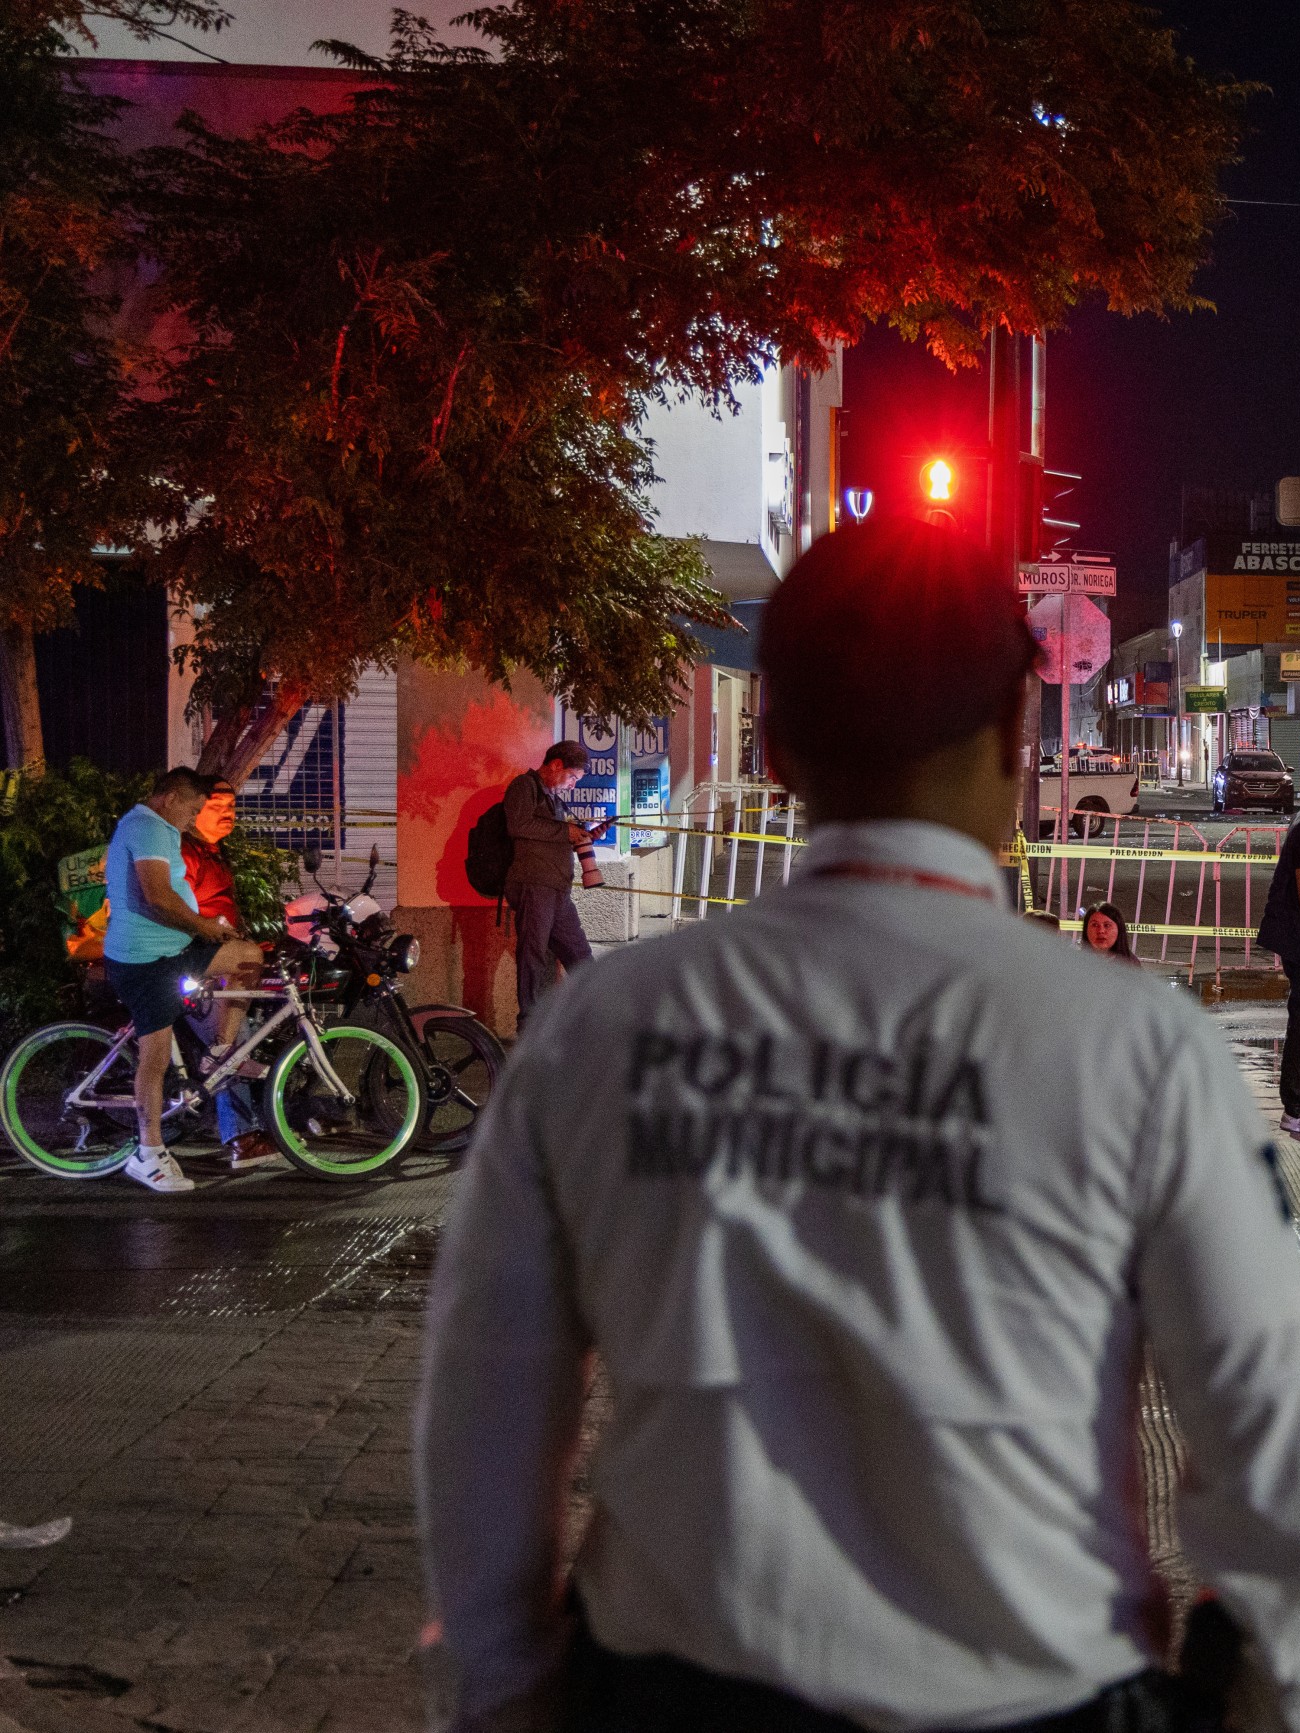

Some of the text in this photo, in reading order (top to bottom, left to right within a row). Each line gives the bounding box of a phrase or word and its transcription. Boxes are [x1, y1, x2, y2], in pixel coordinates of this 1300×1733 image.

[1084, 574, 1114, 588] NORIEGA
[1217, 610, 1267, 620] TRUPER
[575, 788, 616, 803] REVISAR
[1109, 849, 1163, 857] PRECAUCION
